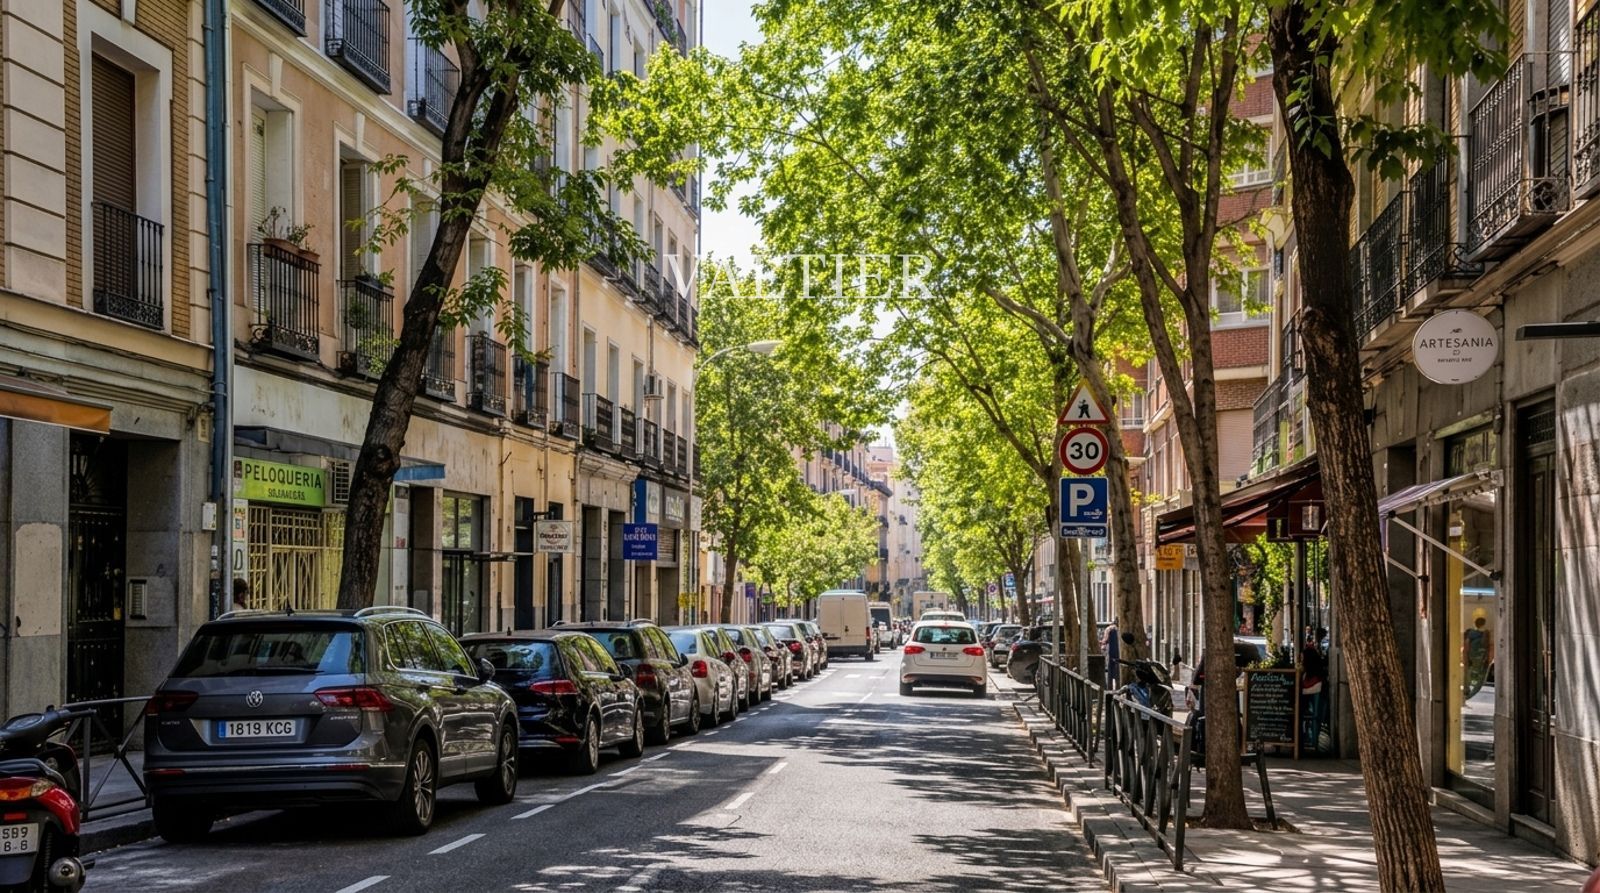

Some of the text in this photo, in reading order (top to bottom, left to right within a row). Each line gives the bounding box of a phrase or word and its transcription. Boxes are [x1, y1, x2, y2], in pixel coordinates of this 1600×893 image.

[1419, 337, 1494, 349] ARTESANIA
[1070, 441, 1099, 460] 30
[244, 463, 322, 489] PELOQUERIA
[1070, 483, 1095, 517] P
[229, 721, 292, 736] 1819 KCG
